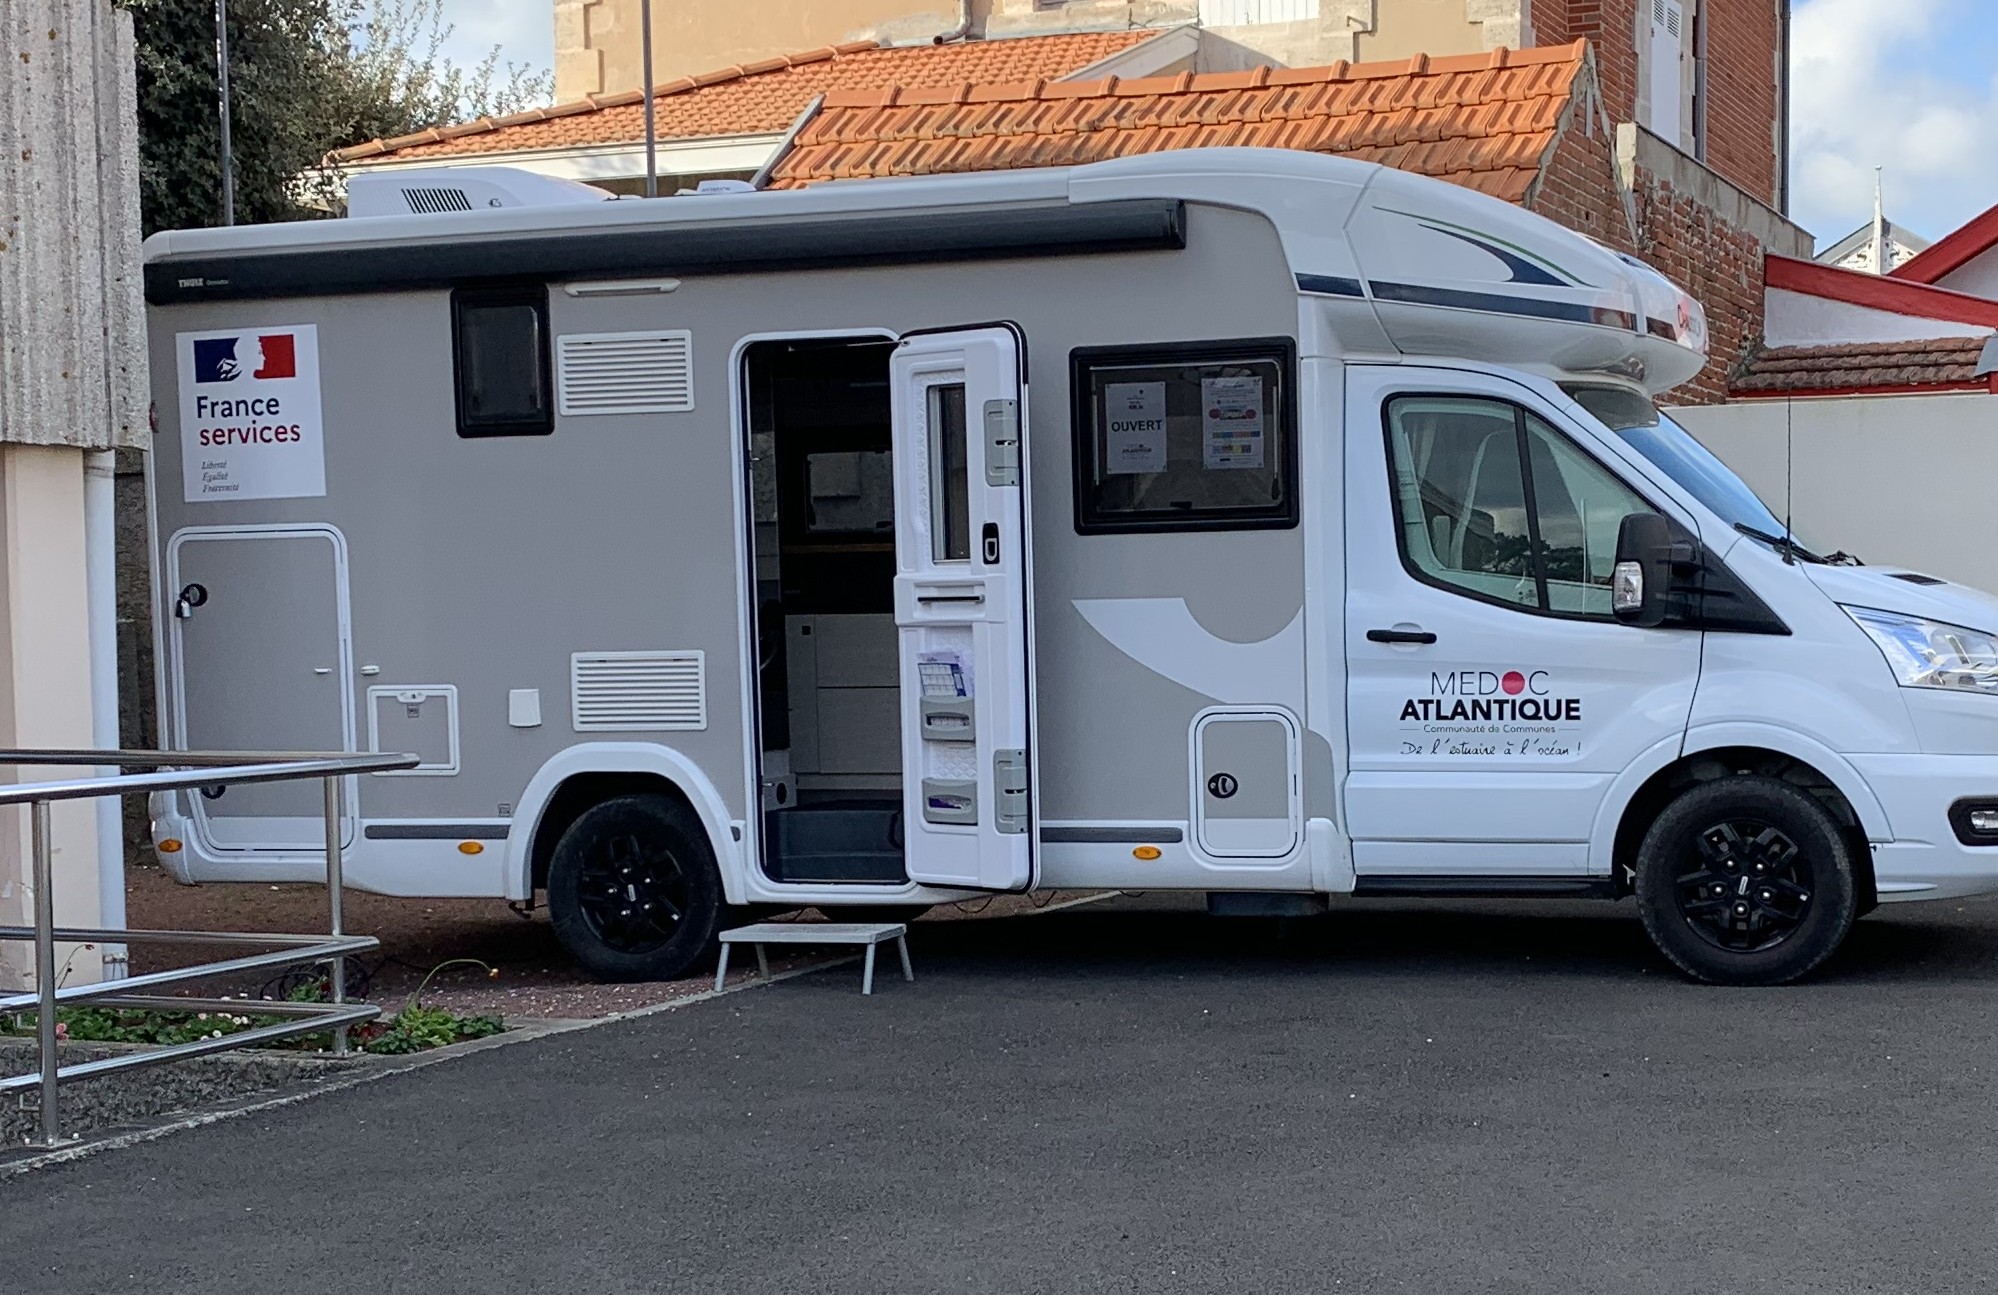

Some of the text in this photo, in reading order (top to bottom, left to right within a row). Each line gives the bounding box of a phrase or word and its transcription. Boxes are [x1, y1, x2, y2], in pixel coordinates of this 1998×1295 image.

[196, 395, 280, 419] France
[199, 420, 301, 447] services
[1111, 419, 1162, 433] OUVERT
[1431, 670, 1550, 696] MEDOC
[1399, 698, 1582, 721] ATLANTIQUE
[1423, 724, 1556, 733] Communauté de Communes
[1400, 741, 1423, 755] De
[1503, 742, 1515, 755] à
